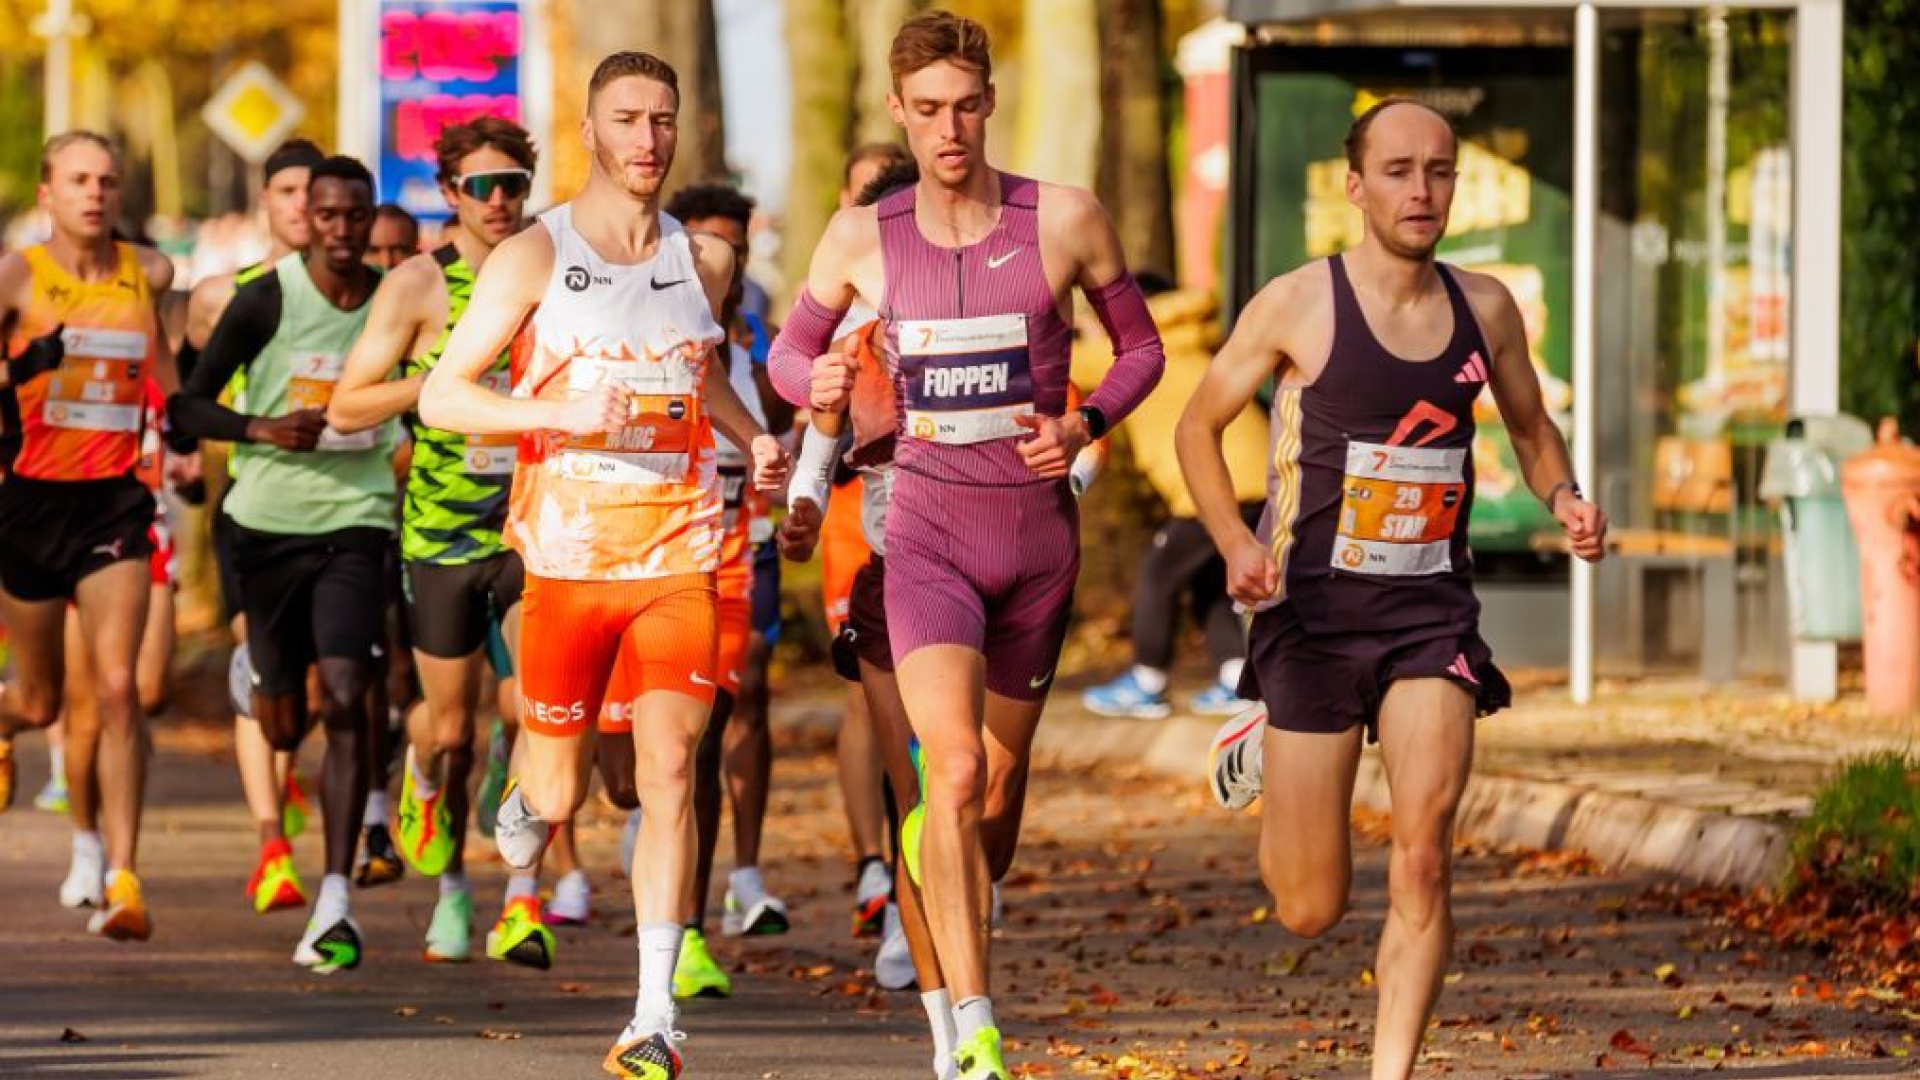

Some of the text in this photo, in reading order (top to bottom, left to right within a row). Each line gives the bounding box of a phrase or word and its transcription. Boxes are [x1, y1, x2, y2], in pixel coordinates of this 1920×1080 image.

[593, 276, 612, 285] NN
[919, 328, 932, 347] 7
[924, 363, 1008, 396] FOPPEN
[605, 426, 656, 449] MARC
[940, 424, 956, 433] NN
[599, 461, 615, 471] NN
[1373, 452, 1388, 471] 7
[1394, 487, 1422, 509] 29
[1369, 552, 1387, 562] NN
